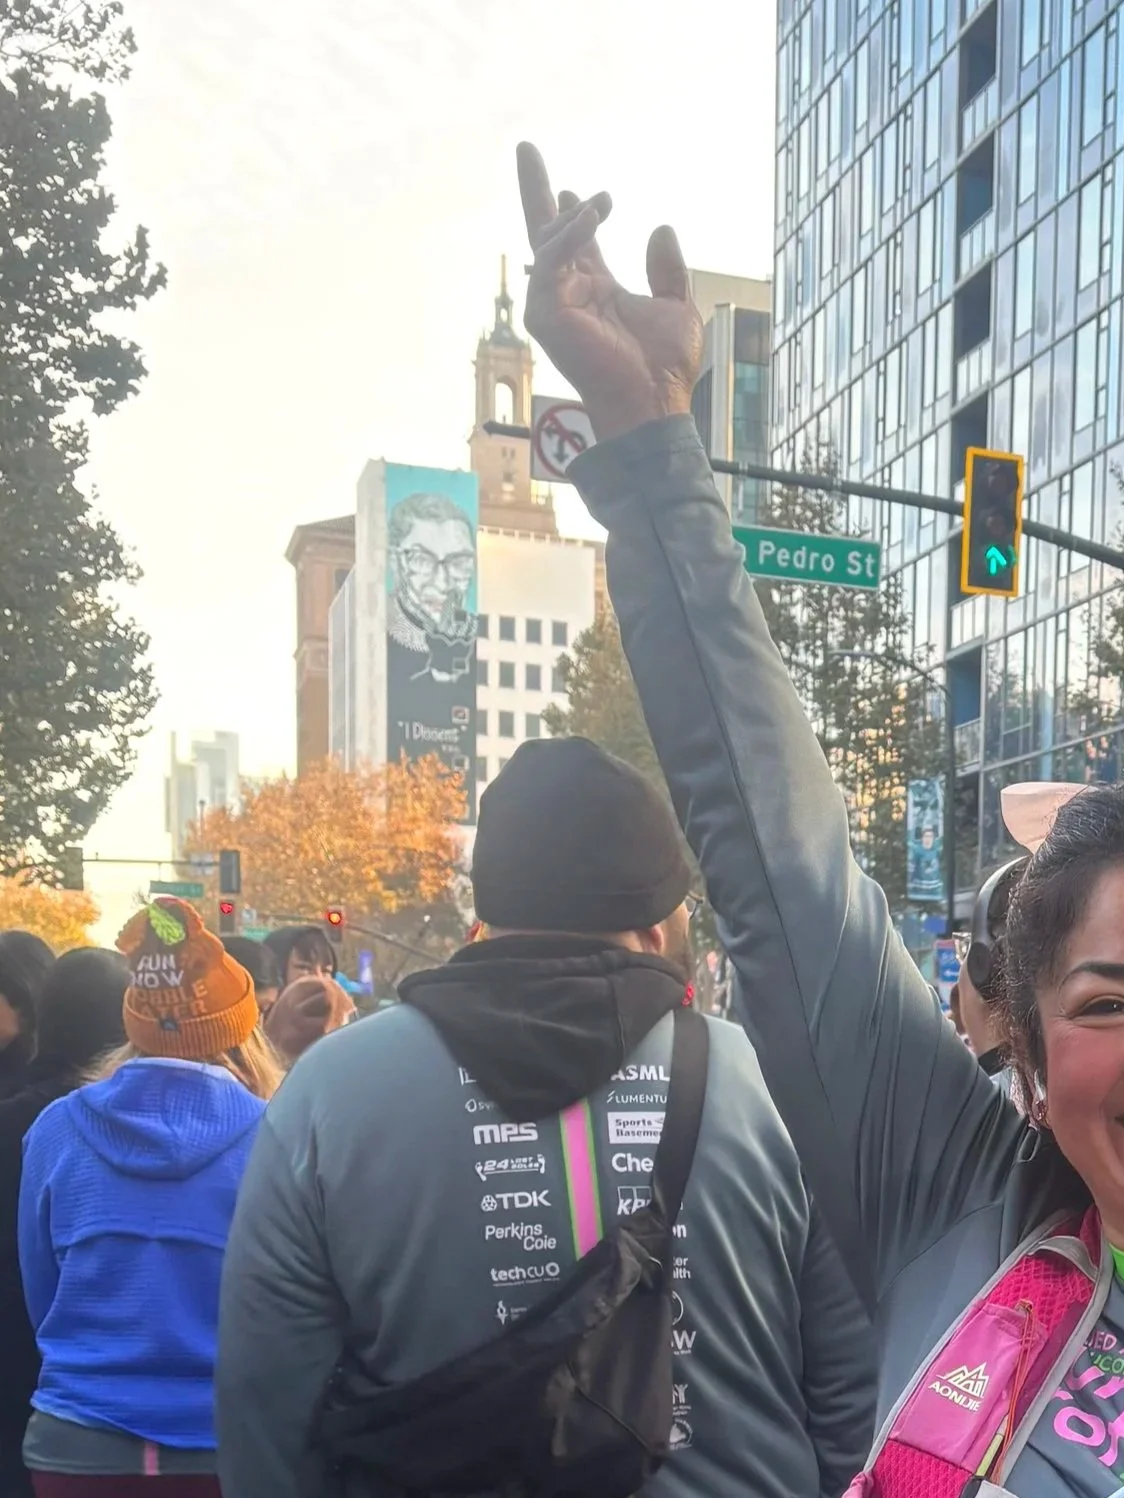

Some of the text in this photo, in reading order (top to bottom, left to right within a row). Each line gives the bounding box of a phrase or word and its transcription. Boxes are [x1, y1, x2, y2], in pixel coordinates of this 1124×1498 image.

[758, 540, 875, 577] Pedro St
[615, 1094, 668, 1104] LUMENTU
[615, 1118, 653, 1130] Sports
[616, 1127, 662, 1138] Baseme
[611, 1153, 653, 1172] Che
[495, 1189, 552, 1210] TDK
[485, 1222, 543, 1241] Perkins
[523, 1235, 557, 1251] Coie
